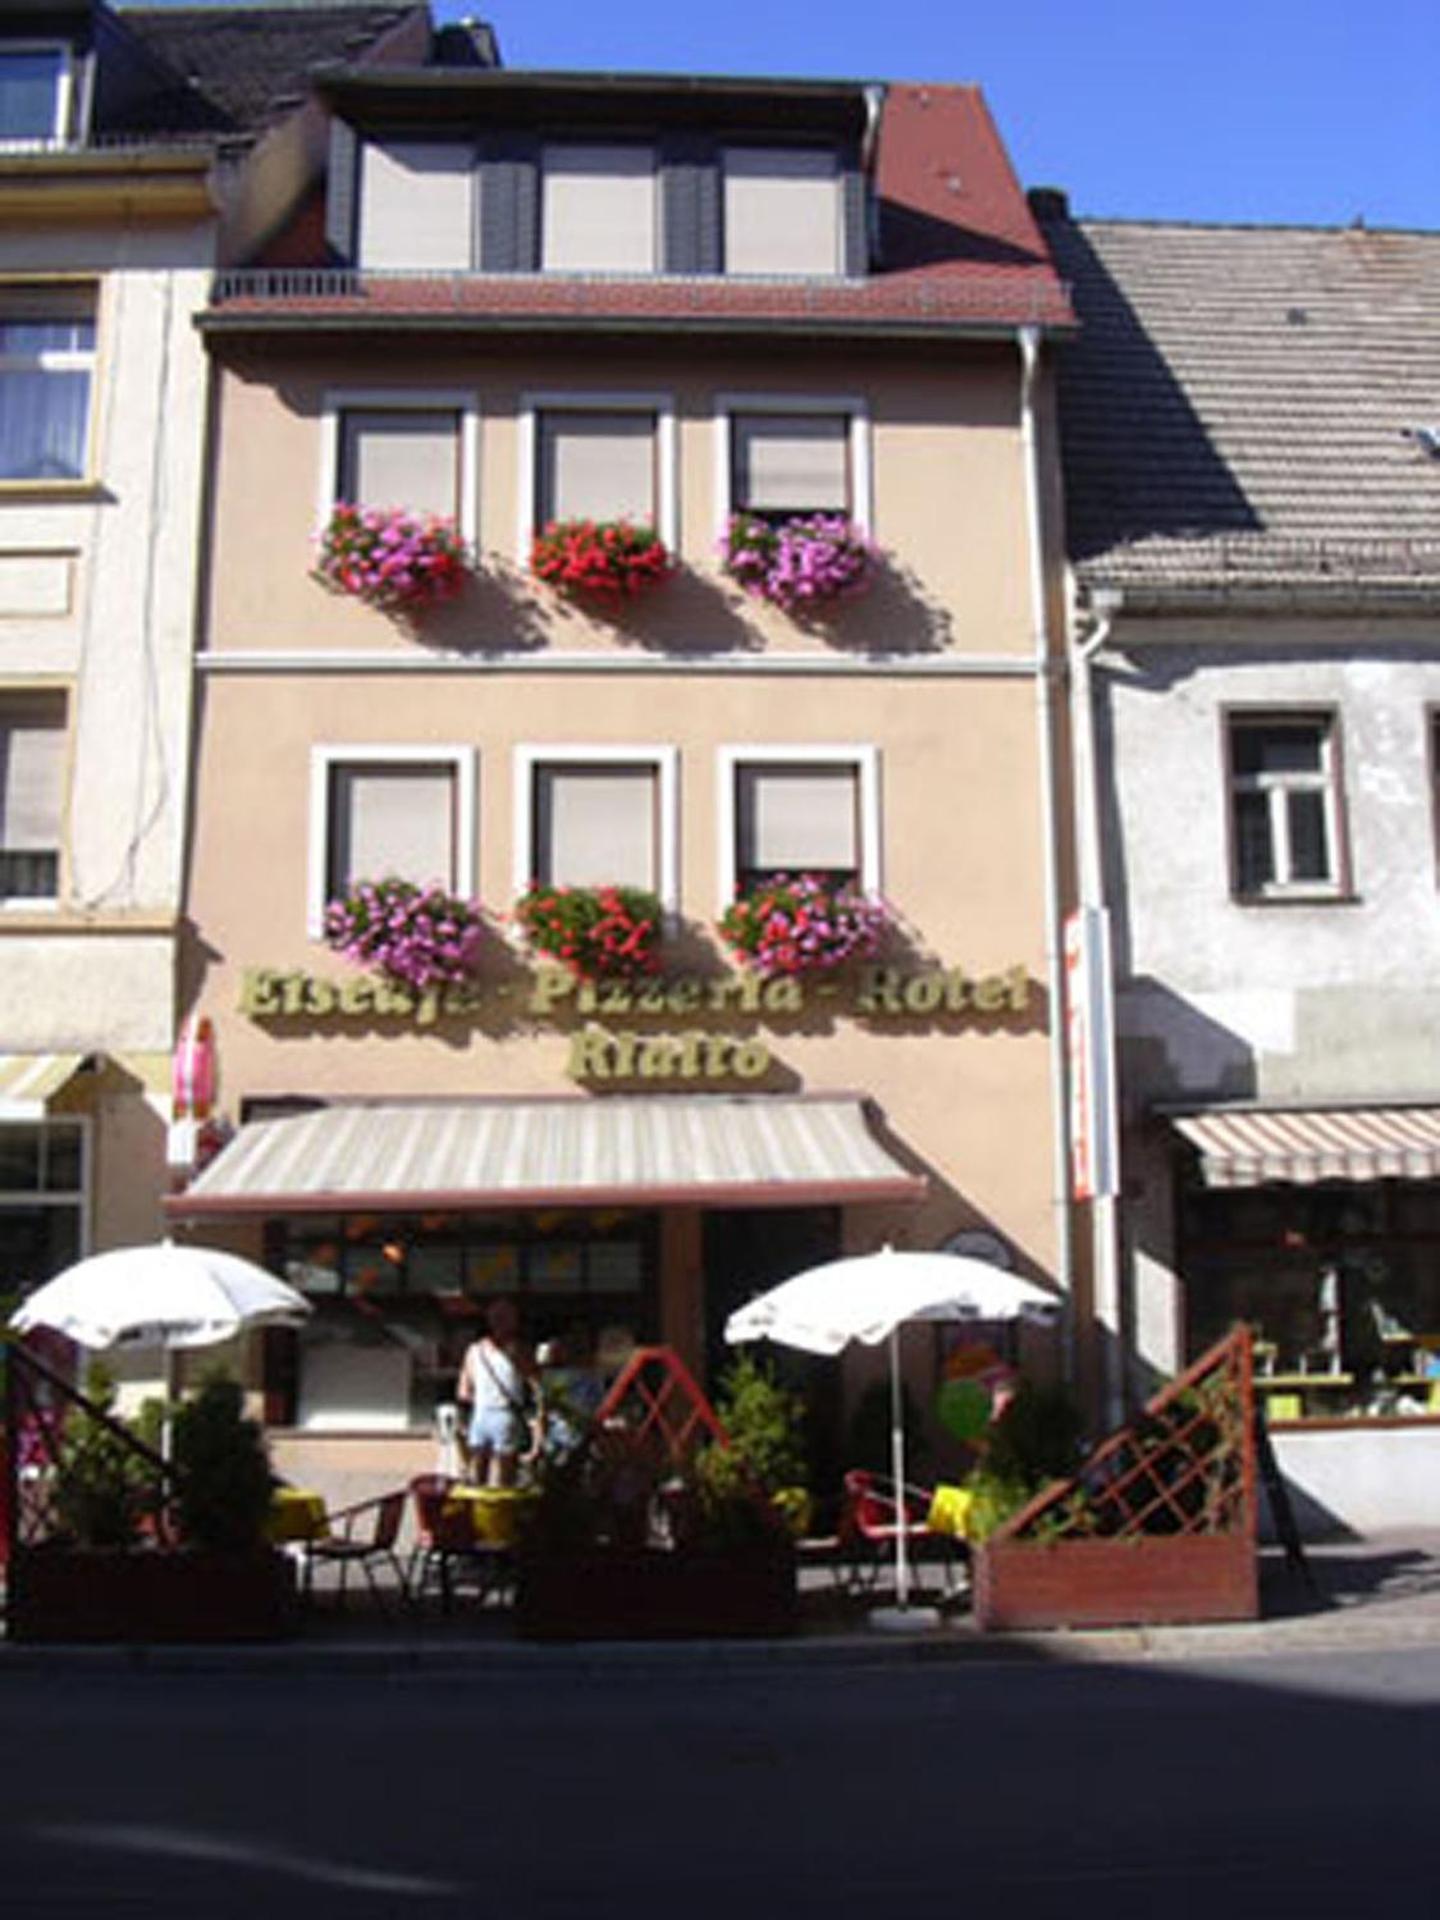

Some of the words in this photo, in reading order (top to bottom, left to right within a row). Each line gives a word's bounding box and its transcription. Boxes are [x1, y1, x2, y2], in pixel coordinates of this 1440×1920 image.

[532, 966, 801, 1013] Pizzeria
[856, 964, 1031, 1012] Hotel
[566, 1029, 771, 1079] Rialto
